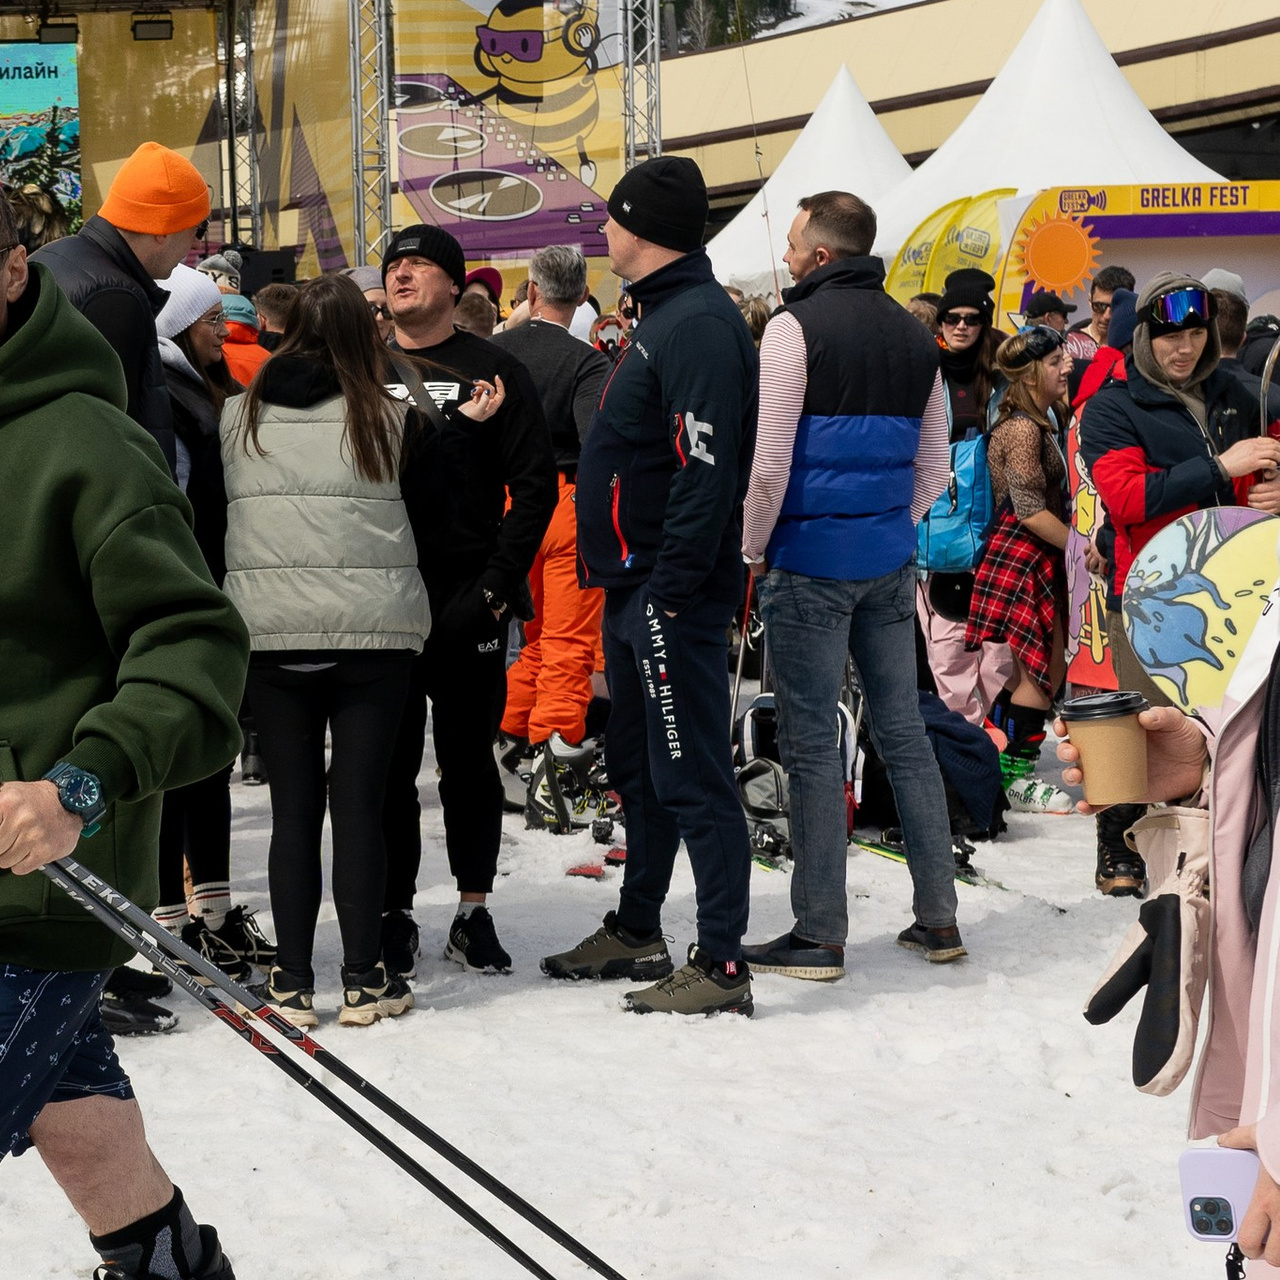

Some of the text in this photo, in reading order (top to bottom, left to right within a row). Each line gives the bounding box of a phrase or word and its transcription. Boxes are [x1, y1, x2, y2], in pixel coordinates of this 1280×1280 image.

[1140, 186, 1250, 208] GRELKA FEST
[478, 638, 499, 652] EA7
[642, 659, 652, 677] EST.
[646, 597, 682, 760] OMMY HILFIGER
[65, 862, 132, 913] LEKI
[120, 922, 207, 997] STREAM
